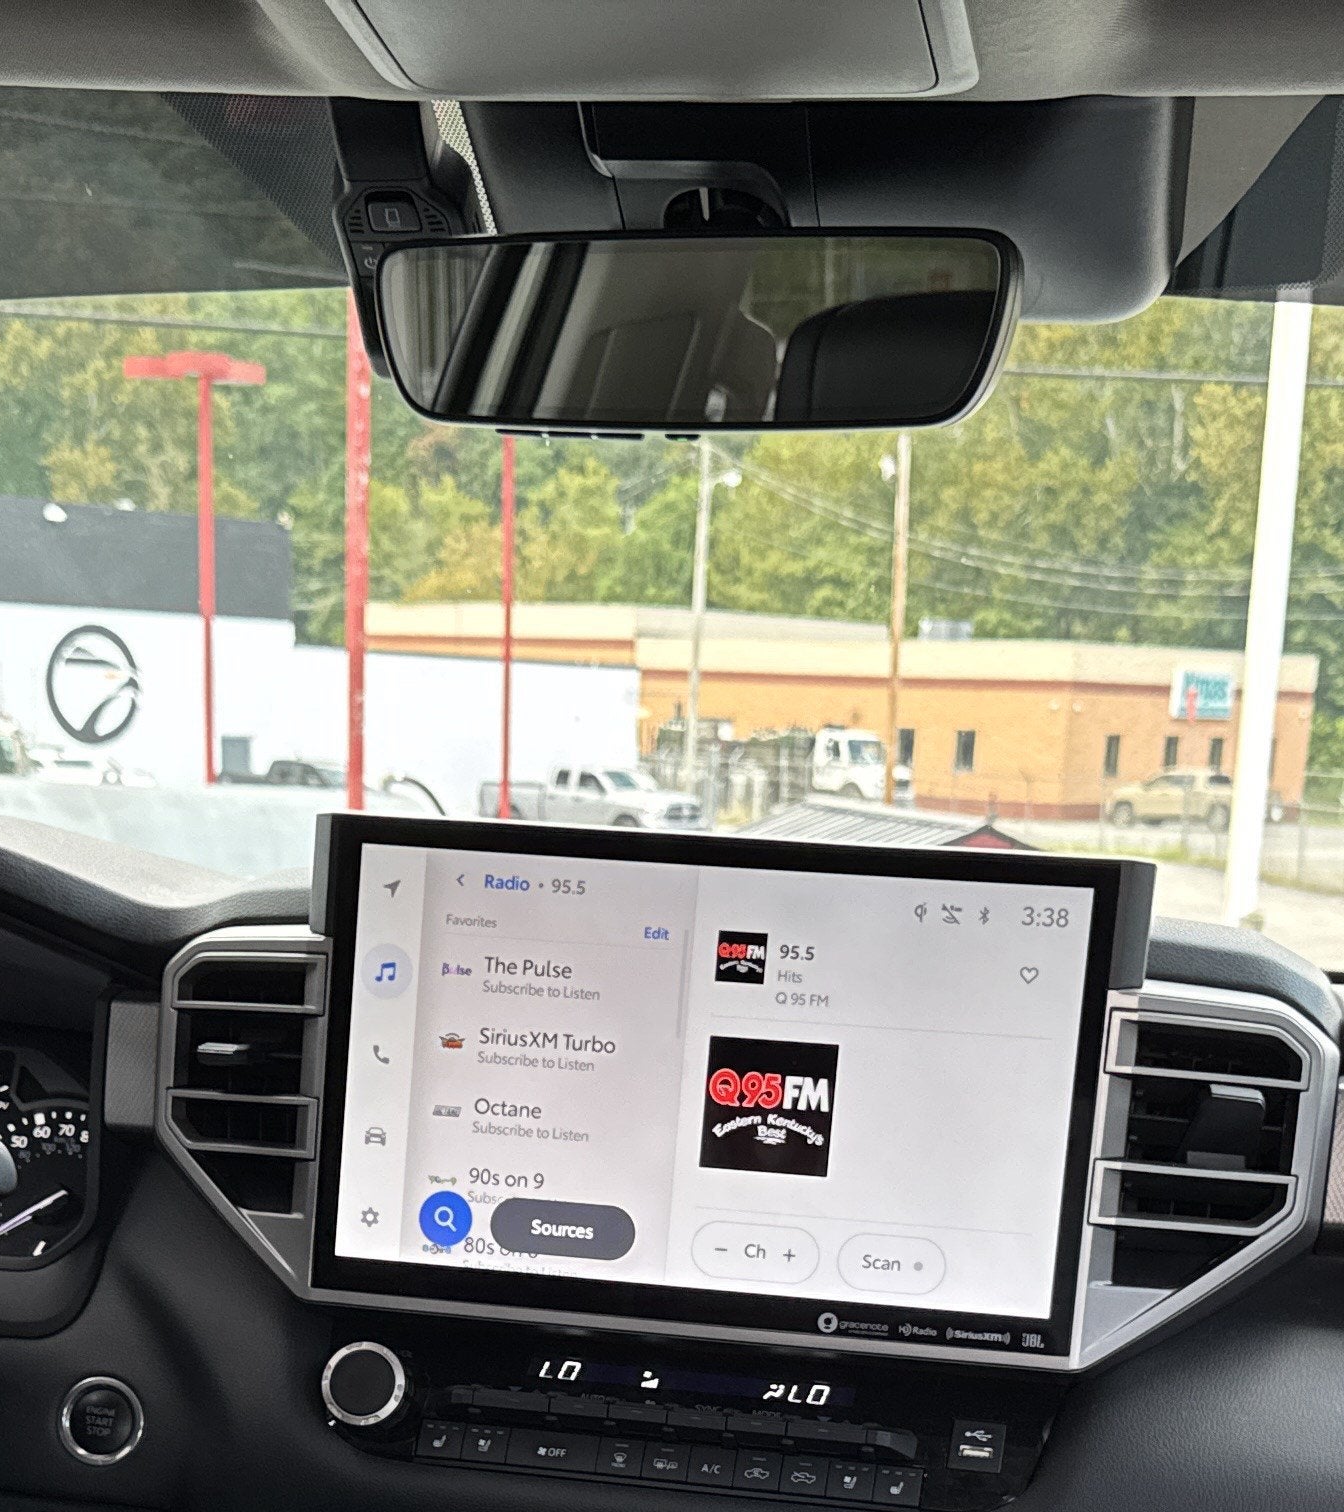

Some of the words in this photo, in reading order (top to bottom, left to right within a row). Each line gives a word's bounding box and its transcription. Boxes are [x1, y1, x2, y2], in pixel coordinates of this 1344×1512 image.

[484, 873, 531, 892] Radio
[551, 878, 587, 896] 95.5
[445, 912, 498, 929] Favorites
[1022, 906, 1069, 928] 3:38
[644, 926, 670, 942] Edit
[779, 944, 815, 962] 95.5
[484, 956, 518, 976] The
[522, 959, 573, 979] Pulse
[777, 969, 803, 984] Hits
[482, 979, 544, 998] Subscribe
[547, 984, 561, 999] to
[563, 984, 601, 1001] Listen
[775, 991, 788, 1006] Q
[791, 993, 807, 1007] 95
[809, 994, 830, 1007] FM
[479, 1027, 559, 1051] SiriusXM
[563, 1033, 616, 1055] Turbo
[477, 1050, 539, 1068] Subscribe
[541, 1055, 555, 1070] to
[557, 1055, 595, 1072] Listen
[474, 1097, 542, 1119] Octane
[32, 1125, 52, 1139] 60
[58, 1123, 76, 1137] 70
[472, 1120, 534, 1139] Subscribe
[536, 1125, 550, 1140] to
[552, 1125, 590, 1142] Listen
[712, 1115, 762, 1137] Eastern
[757, 1125, 787, 1140] Best
[10, 1134, 29, 1149] 50
[469, 1167, 500, 1187] 90s
[505, 1174, 529, 1189] on
[533, 1172, 545, 1189] 9
[531, 1218, 594, 1240] Sources
[464, 1236, 495, 1255] 80s
[744, 1243, 766, 1260] Ch
[861, 1254, 901, 1272] Scan
[1022, 1332, 1045, 1350] JBL
[547, 1447, 567, 1458] OFF
[700, 1463, 722, 1475] A/C
